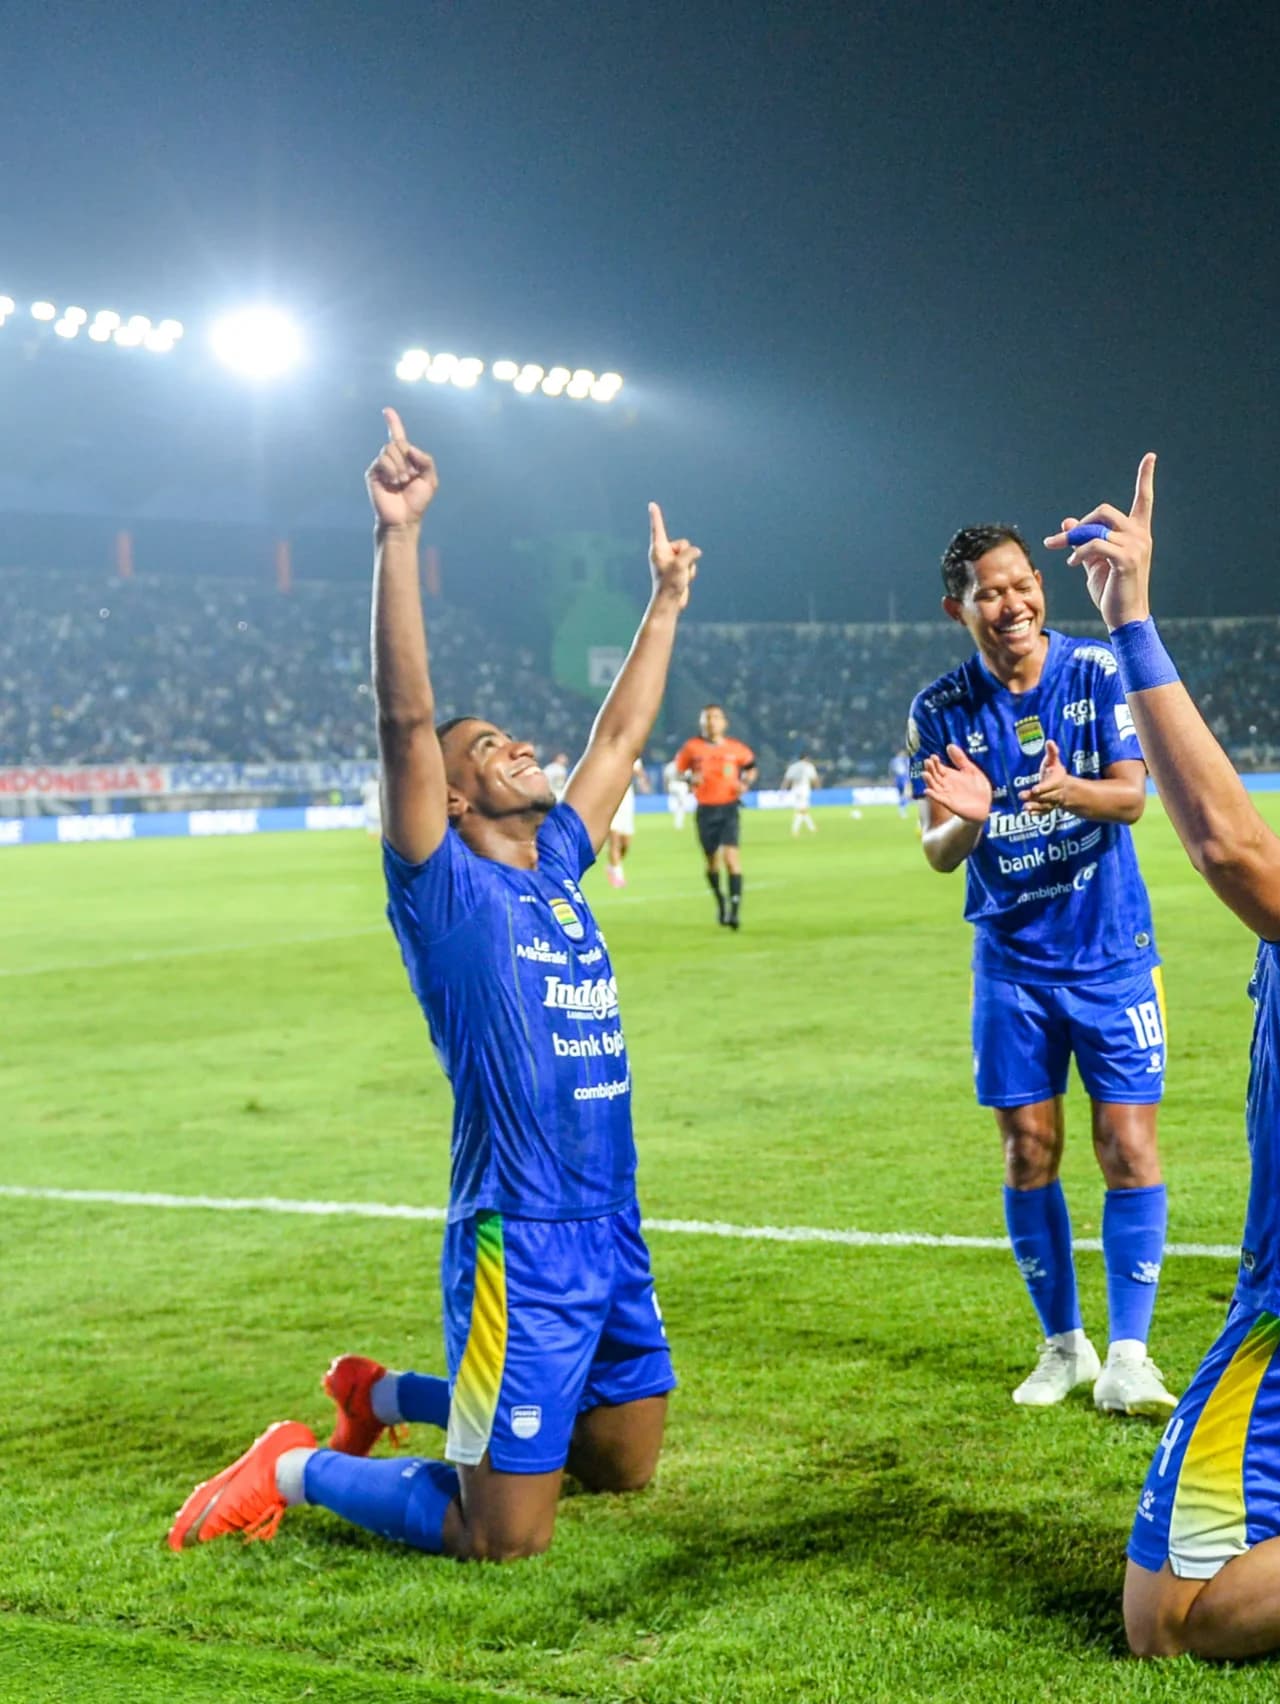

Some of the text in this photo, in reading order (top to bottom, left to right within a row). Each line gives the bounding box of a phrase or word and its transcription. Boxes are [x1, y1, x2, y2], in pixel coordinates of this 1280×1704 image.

[998, 838, 1080, 875] bank bjb
[552, 1031, 602, 1057] bank
[1125, 1001, 1163, 1050] 18
[1158, 1417, 1185, 1478] 4
